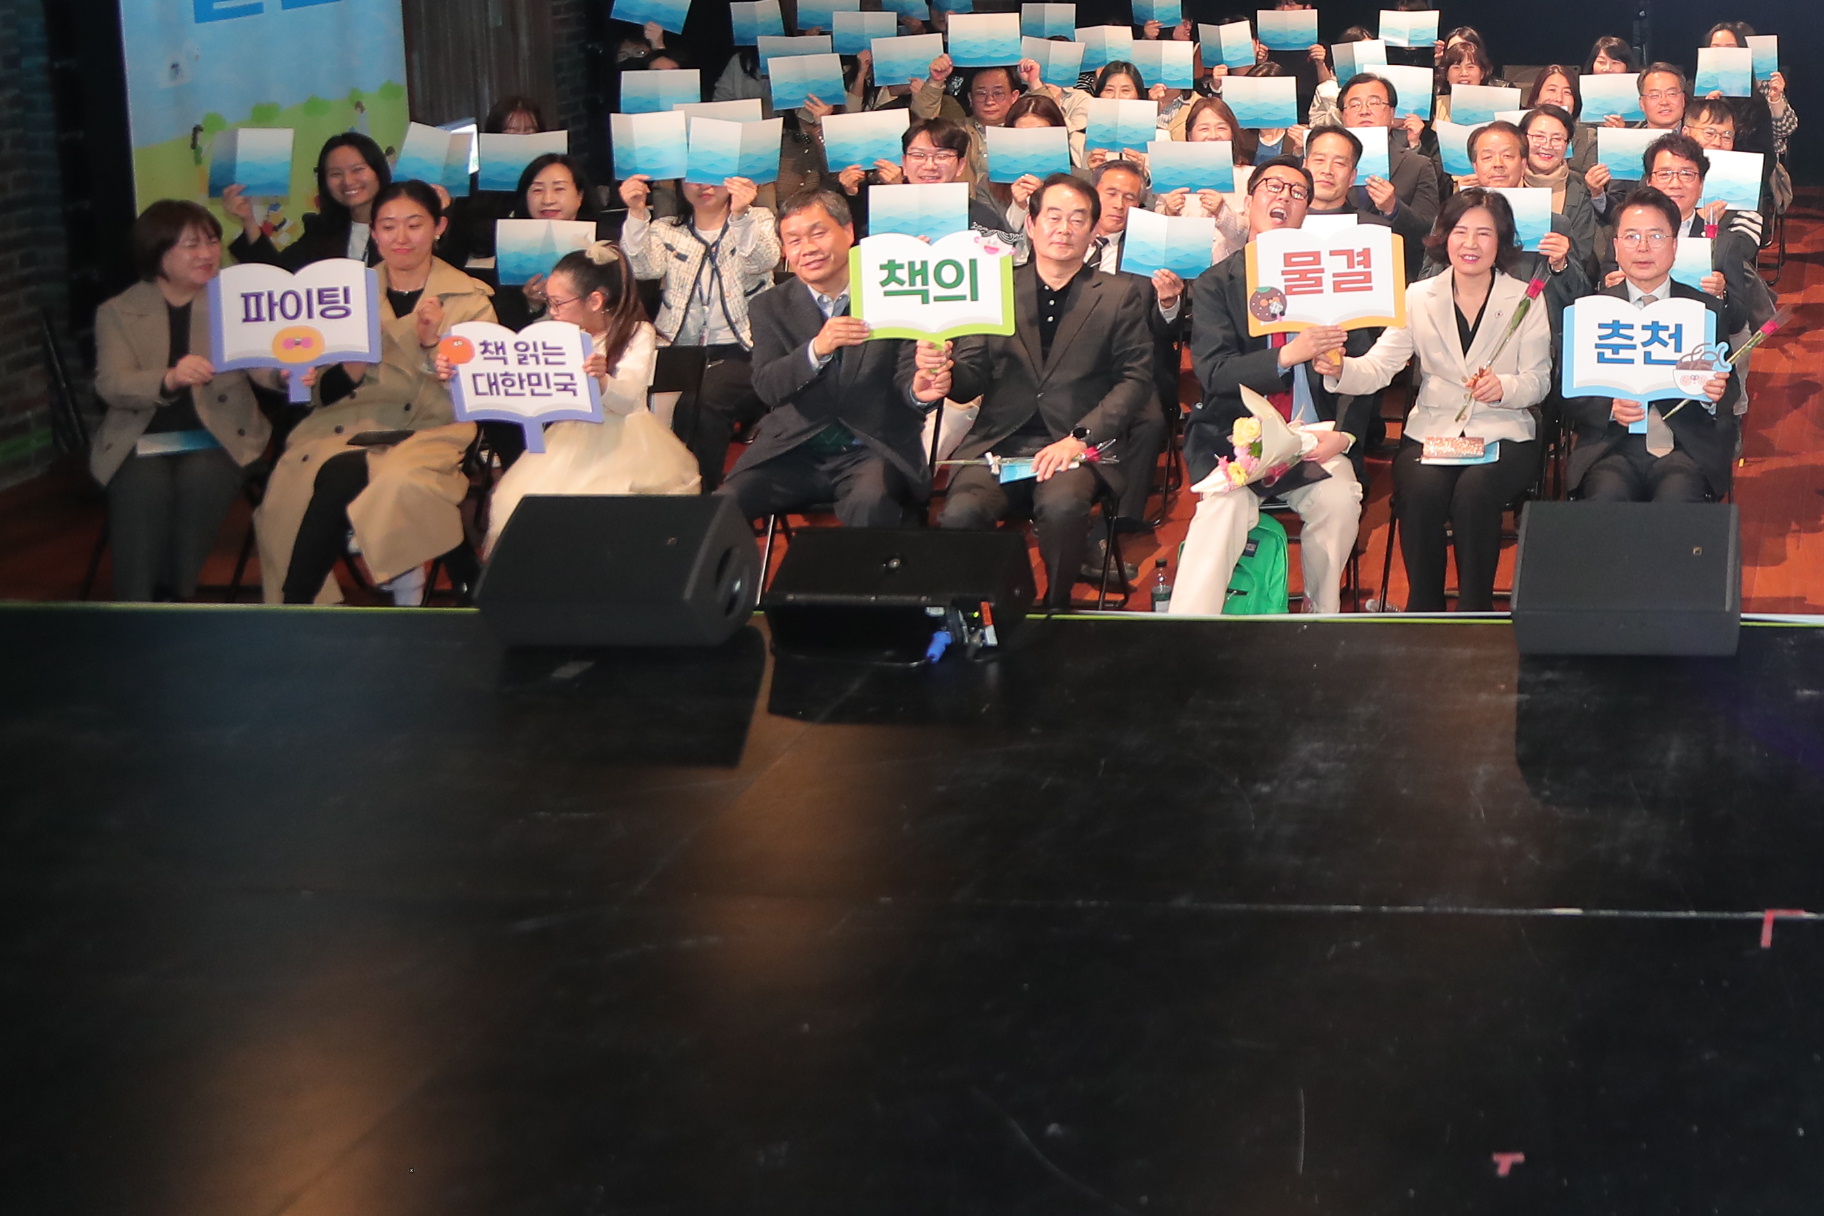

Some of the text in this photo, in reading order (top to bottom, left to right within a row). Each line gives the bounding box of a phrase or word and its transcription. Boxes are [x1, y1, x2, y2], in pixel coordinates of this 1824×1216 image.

[879, 257, 979, 304] 책의
[1281, 246, 1374, 296] 물결
[240, 286, 353, 324] 파이팅
[479, 339, 566, 367] 책 읽는
[1595, 319, 1683, 366] 춘천
[472, 371, 578, 399] 대한민국
